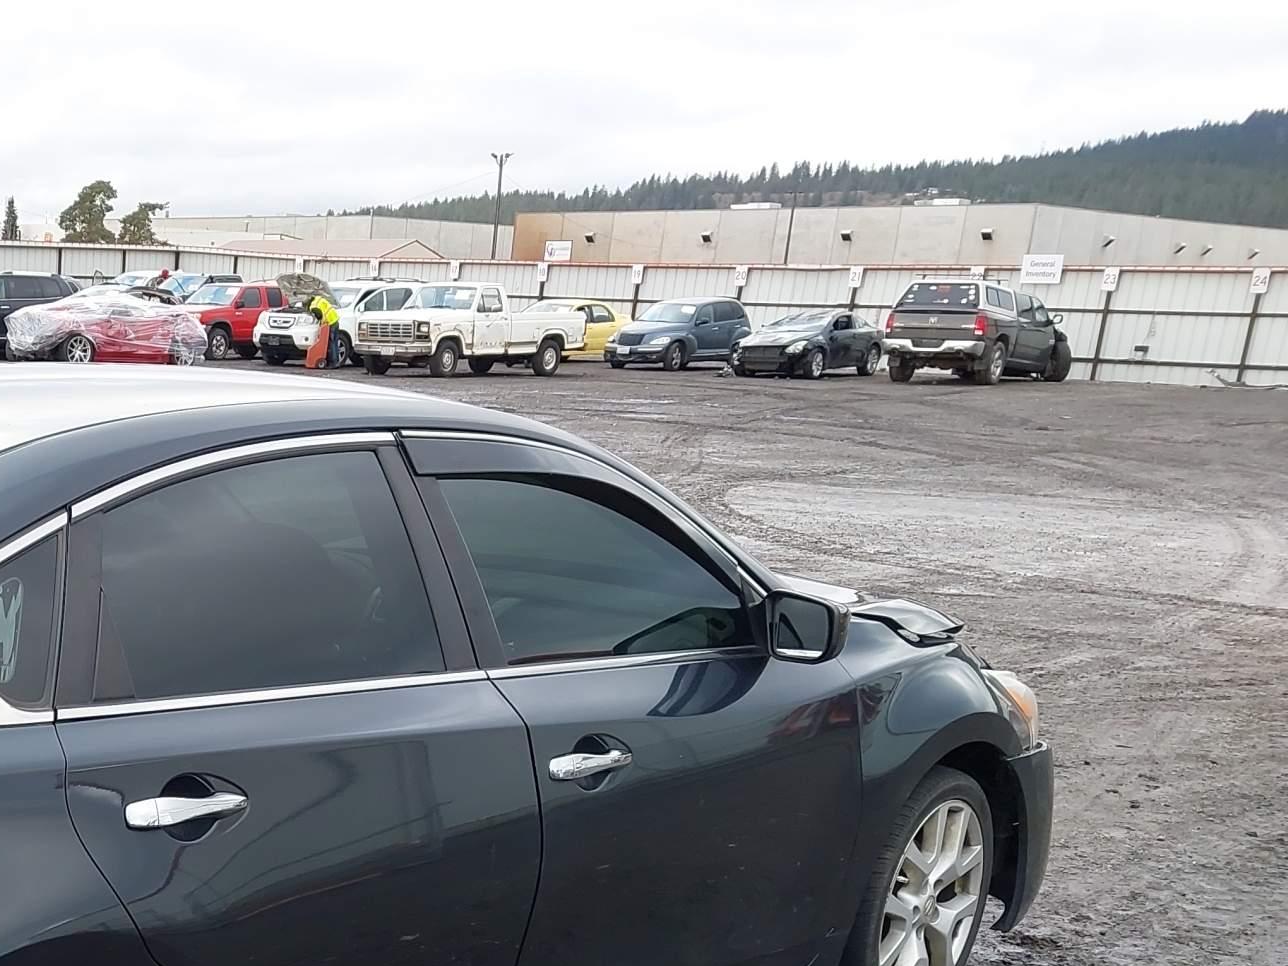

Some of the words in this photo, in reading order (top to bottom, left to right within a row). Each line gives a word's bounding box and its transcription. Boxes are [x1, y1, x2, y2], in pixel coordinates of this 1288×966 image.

[735, 270, 747, 280] 20
[849, 271, 861, 282] 21
[1025, 270, 1056, 278] Inventory
[1103, 273, 1117, 285] 23
[1252, 275, 1268, 287] 24
